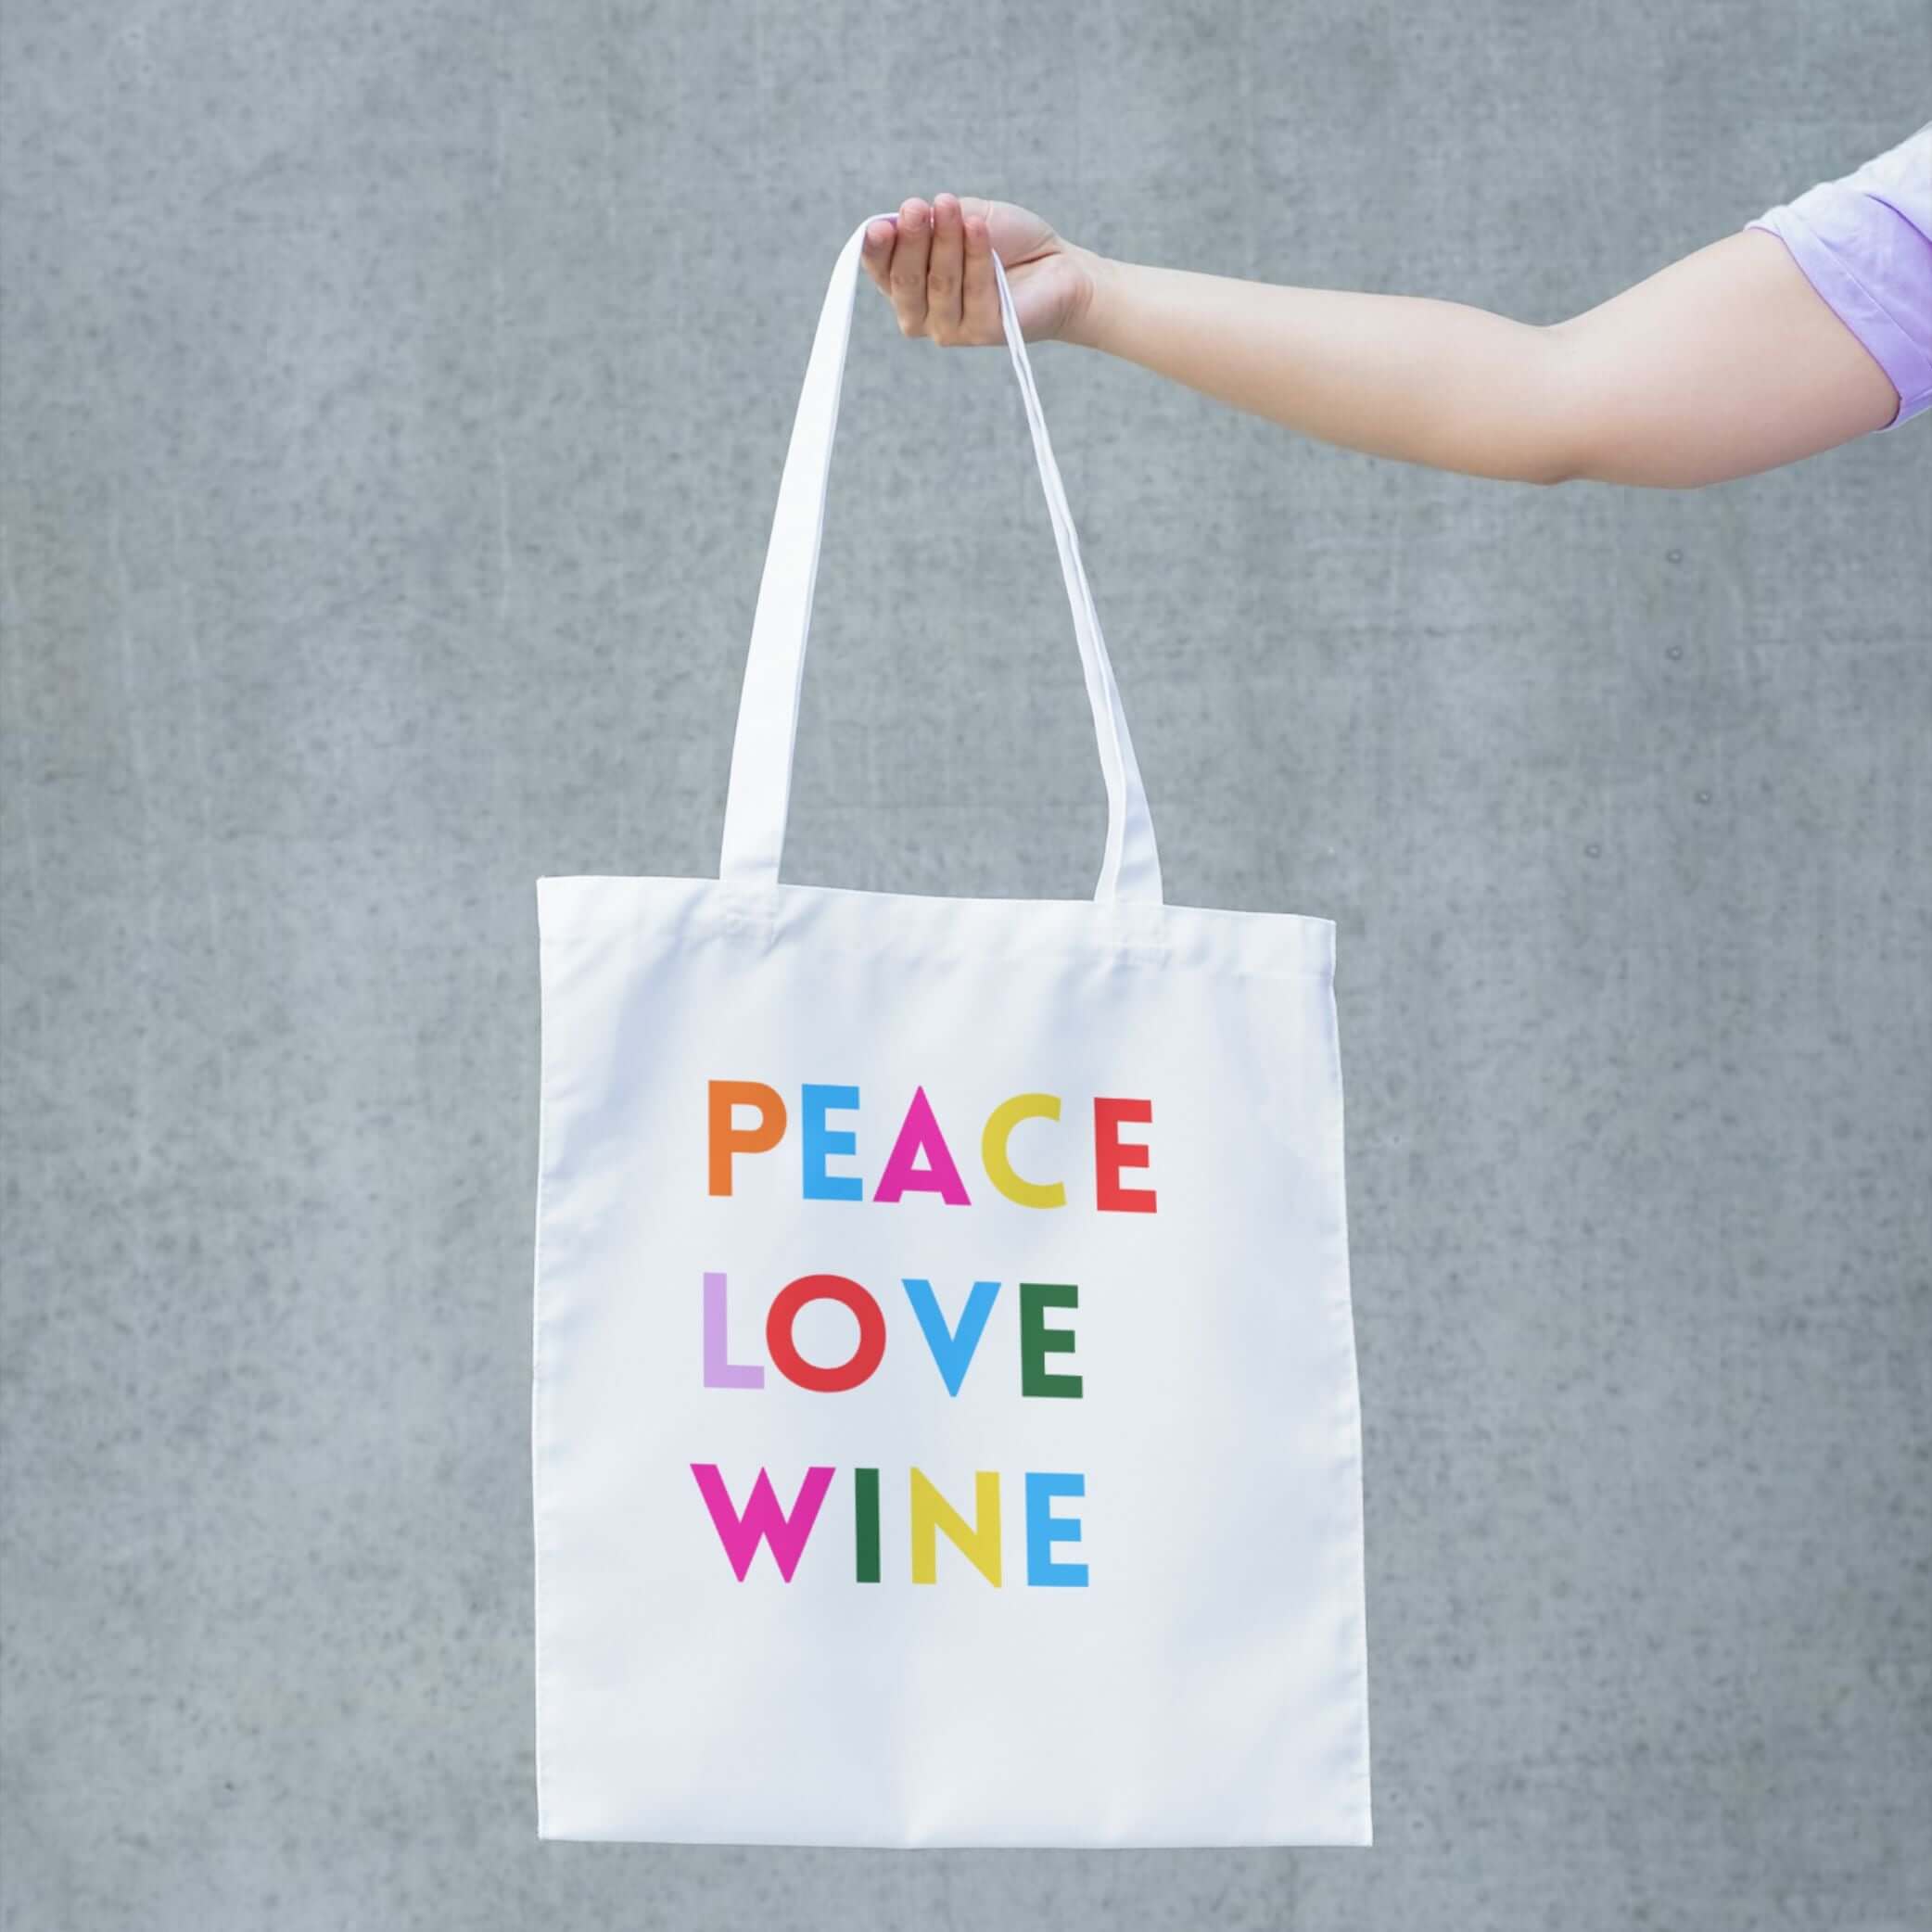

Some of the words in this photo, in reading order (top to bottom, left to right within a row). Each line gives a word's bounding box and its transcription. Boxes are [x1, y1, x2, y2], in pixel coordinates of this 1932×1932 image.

[708, 1080, 1157, 1214] PEACE
[704, 1273, 1083, 1399] LOVE
[691, 1464, 1089, 1588] WINE
